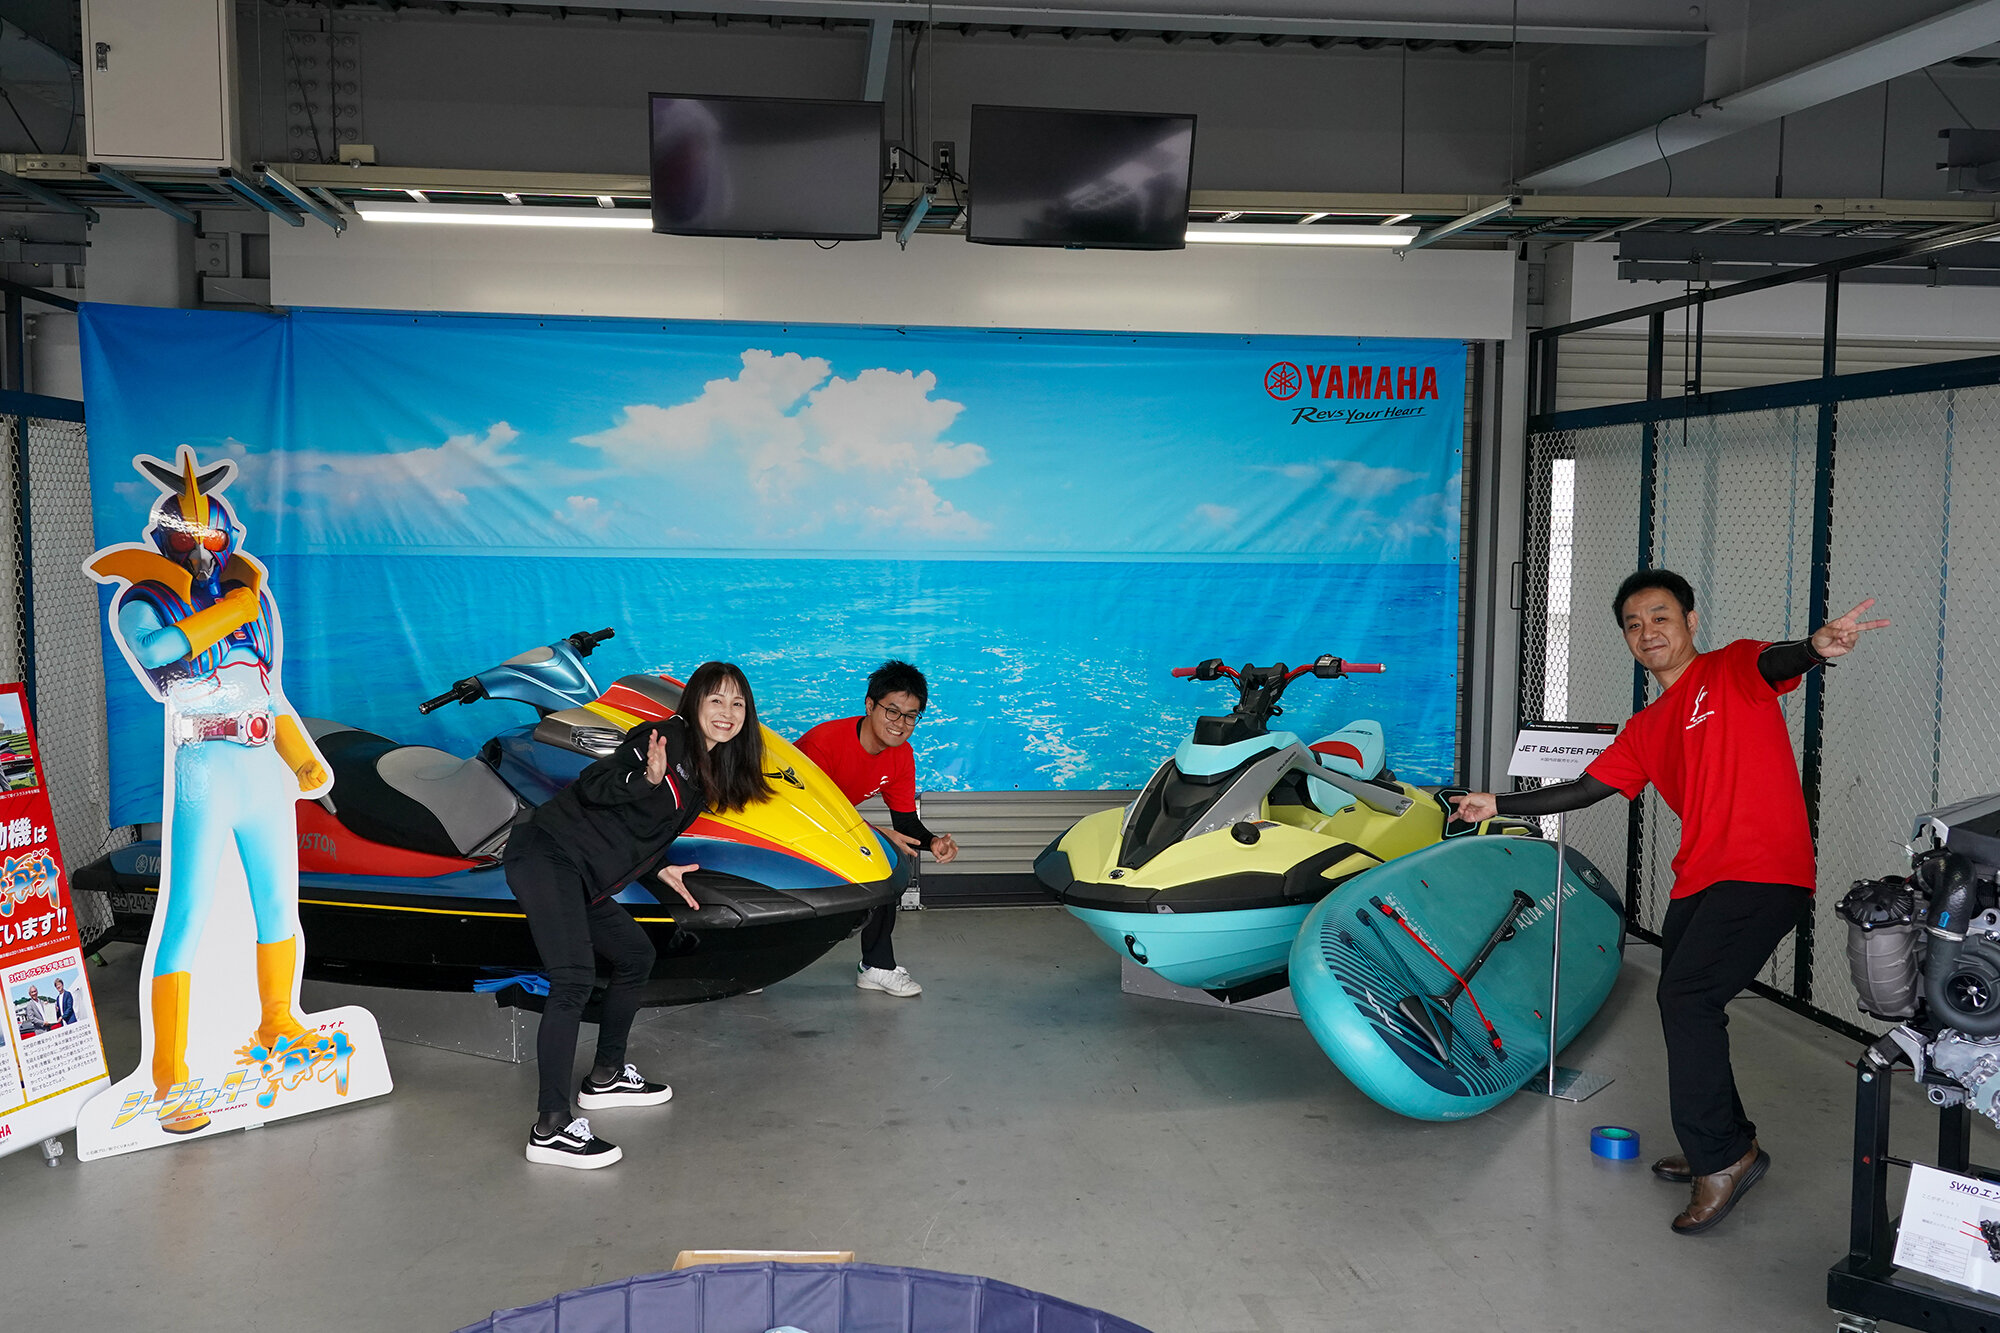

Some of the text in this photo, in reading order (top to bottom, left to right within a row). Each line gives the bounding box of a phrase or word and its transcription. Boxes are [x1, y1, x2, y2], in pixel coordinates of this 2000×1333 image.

[1306, 365, 1439, 400] YAMAHA
[1291, 406, 1426, 425] Revs Your Heart
[1539, 746, 1584, 755] BLASTER
[1515, 906, 1545, 931] AQUA
[1540, 883, 1578, 912] MAINA
[0, 907, 68, 948] います!!
[319, 1020, 345, 1031] カイト
[111, 1069, 261, 1130] シージェッター
[175, 1102, 248, 1123] SEA JETTER KAITO
